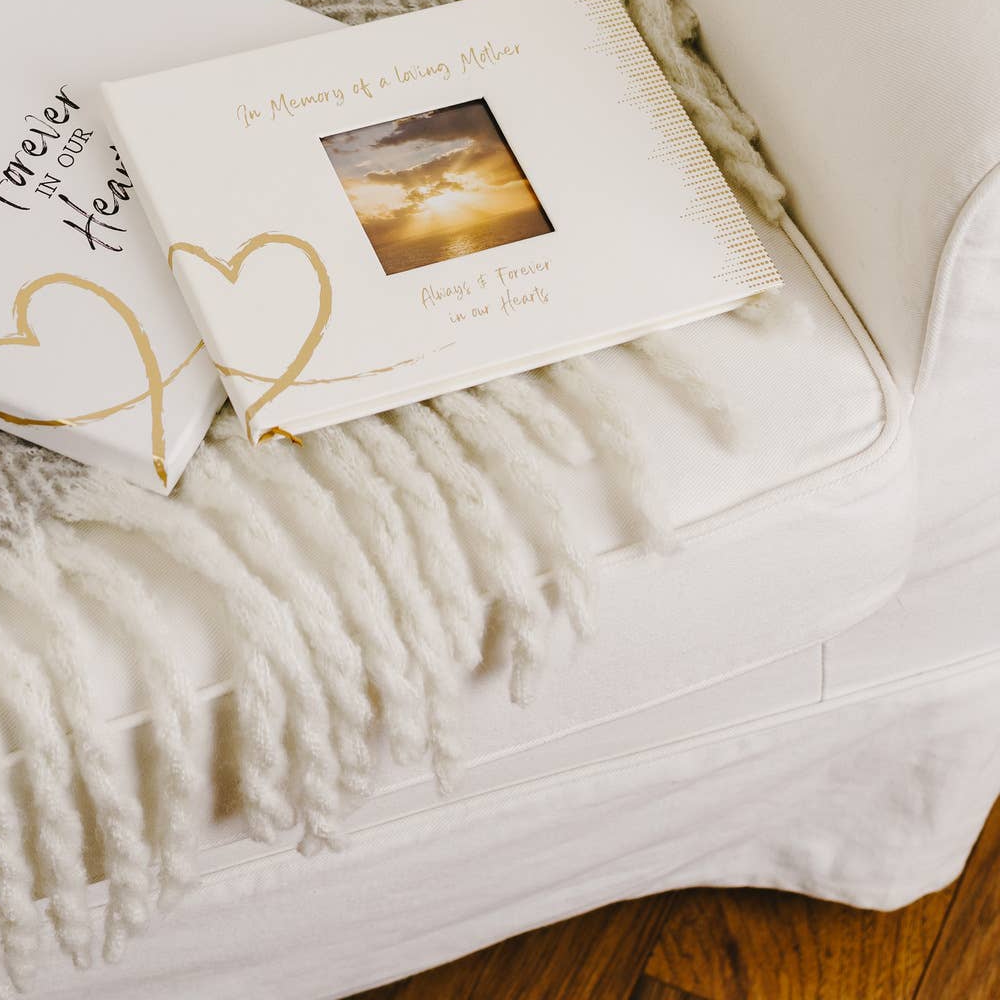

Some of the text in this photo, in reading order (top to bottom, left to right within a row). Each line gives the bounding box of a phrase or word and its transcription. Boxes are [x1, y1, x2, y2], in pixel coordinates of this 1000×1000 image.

[236, 40, 521, 128] In Memory of a loving Mother
[35, 128, 94, 199] IN OUR
[420, 281, 471, 310] Always
[496, 260, 551, 286] Forever
[449, 287, 549, 324] in our Hearts
